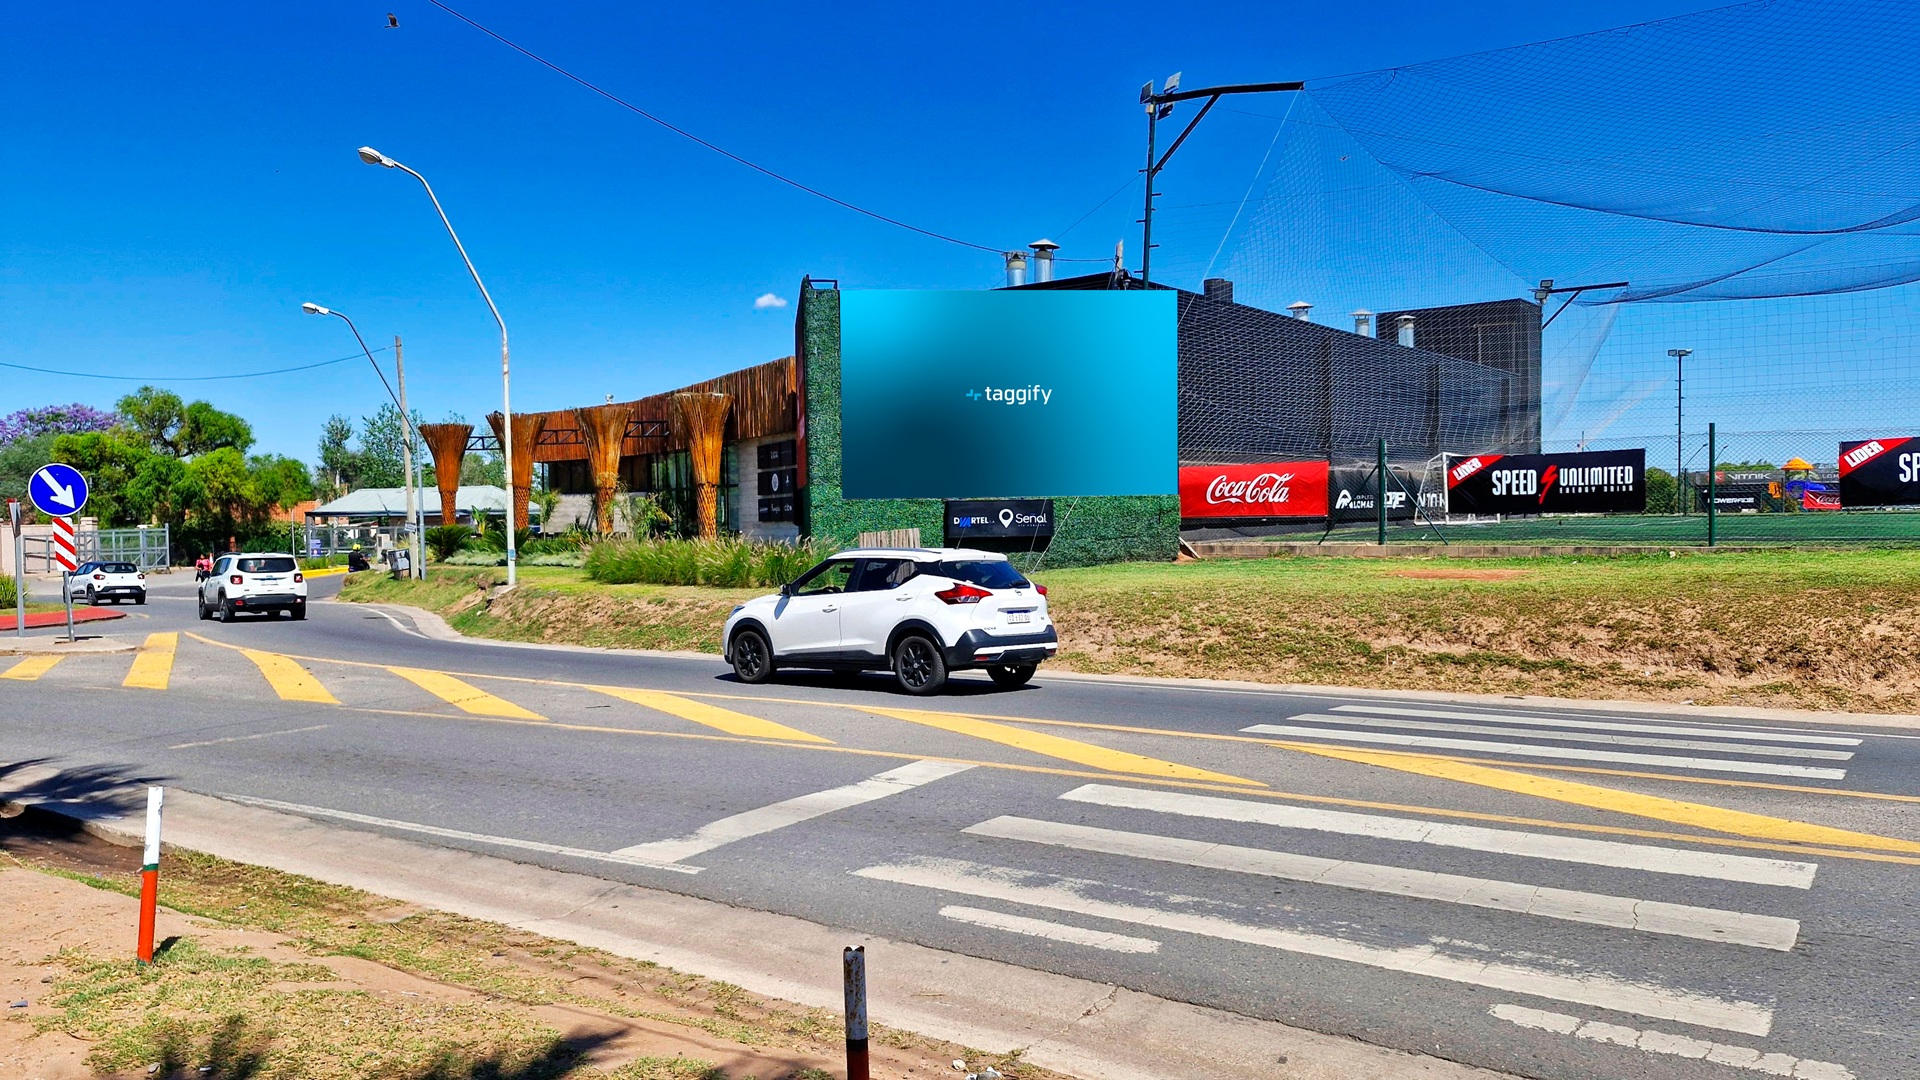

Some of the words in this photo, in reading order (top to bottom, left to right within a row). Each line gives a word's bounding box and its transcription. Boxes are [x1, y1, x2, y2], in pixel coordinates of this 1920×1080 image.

[985, 385, 1052, 405] taggify
[1844, 441, 1884, 468] LIDER
[1206, 473, 1295, 504] Coca-Cola
[1491, 469, 1537, 496] SPEED
[1559, 465, 1634, 487] UNLIMITED
